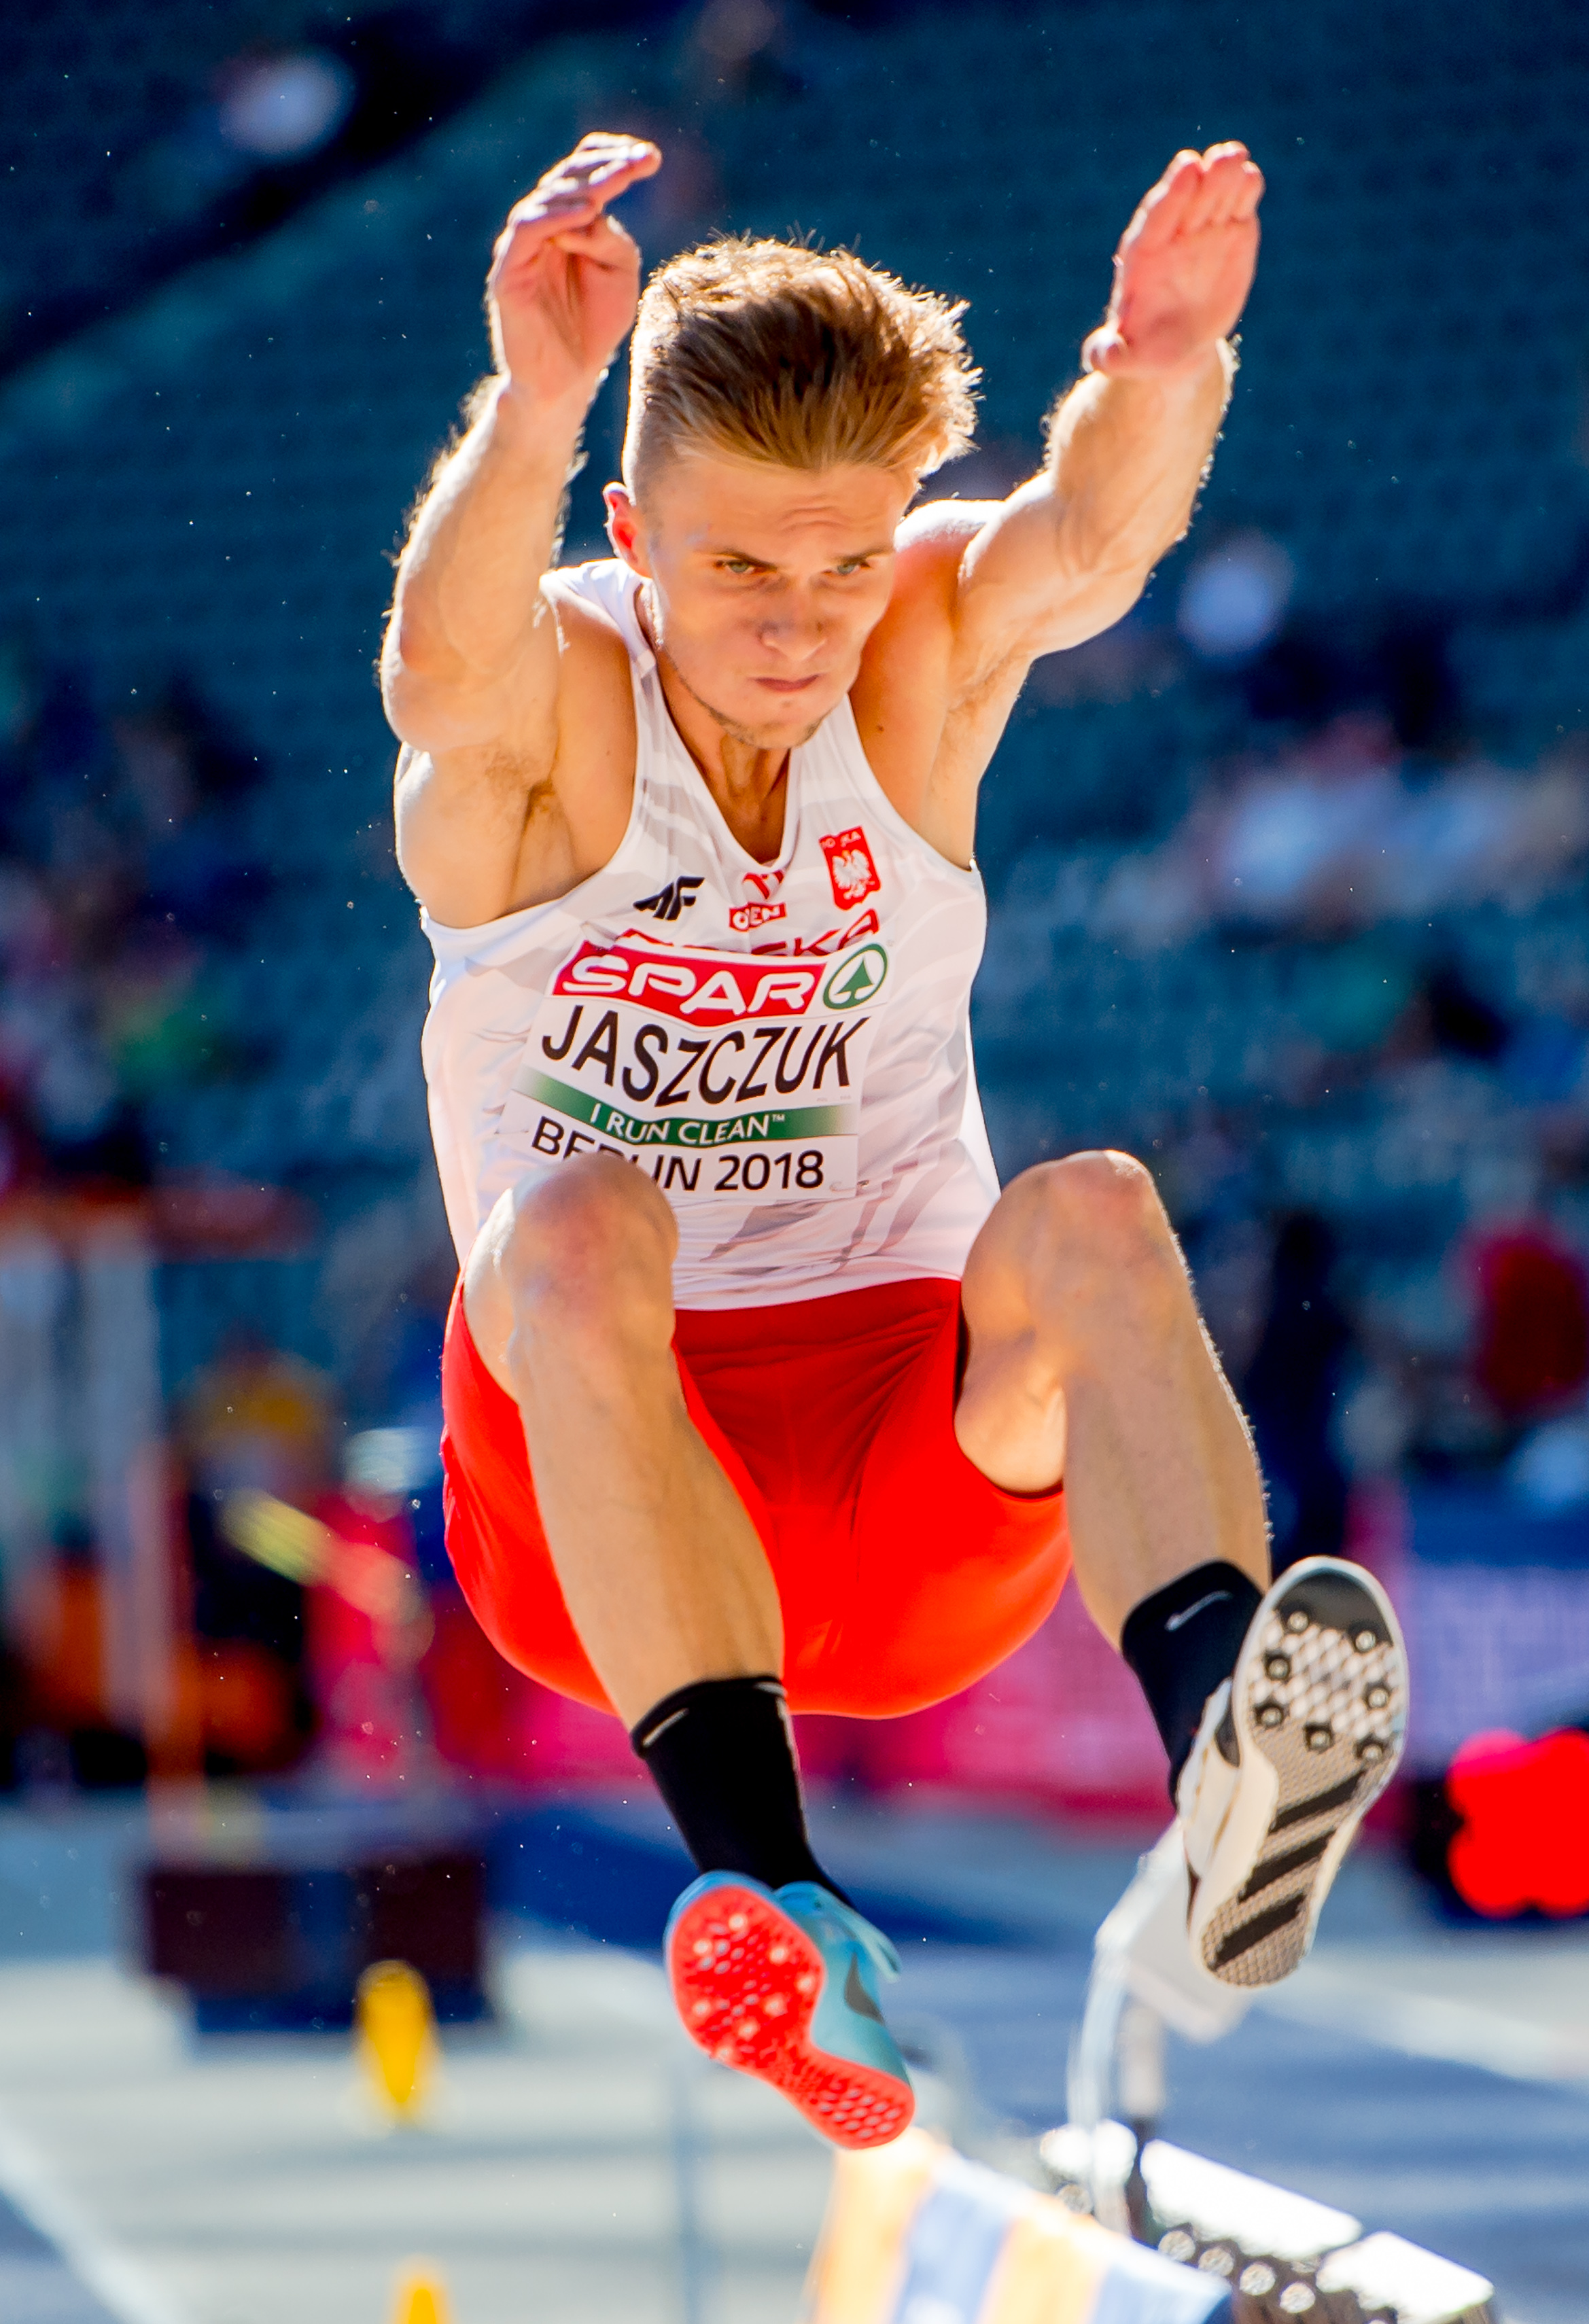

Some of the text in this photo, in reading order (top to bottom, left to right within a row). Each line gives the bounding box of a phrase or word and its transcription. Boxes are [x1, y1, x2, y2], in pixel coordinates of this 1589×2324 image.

[562, 954, 816, 1016] SPAR
[542, 1004, 871, 1107] JASZCZUK
[531, 1116, 824, 1191] BEIN 2018
[590, 1103, 601, 1123] I
[606, 1110, 669, 1143] RUN
